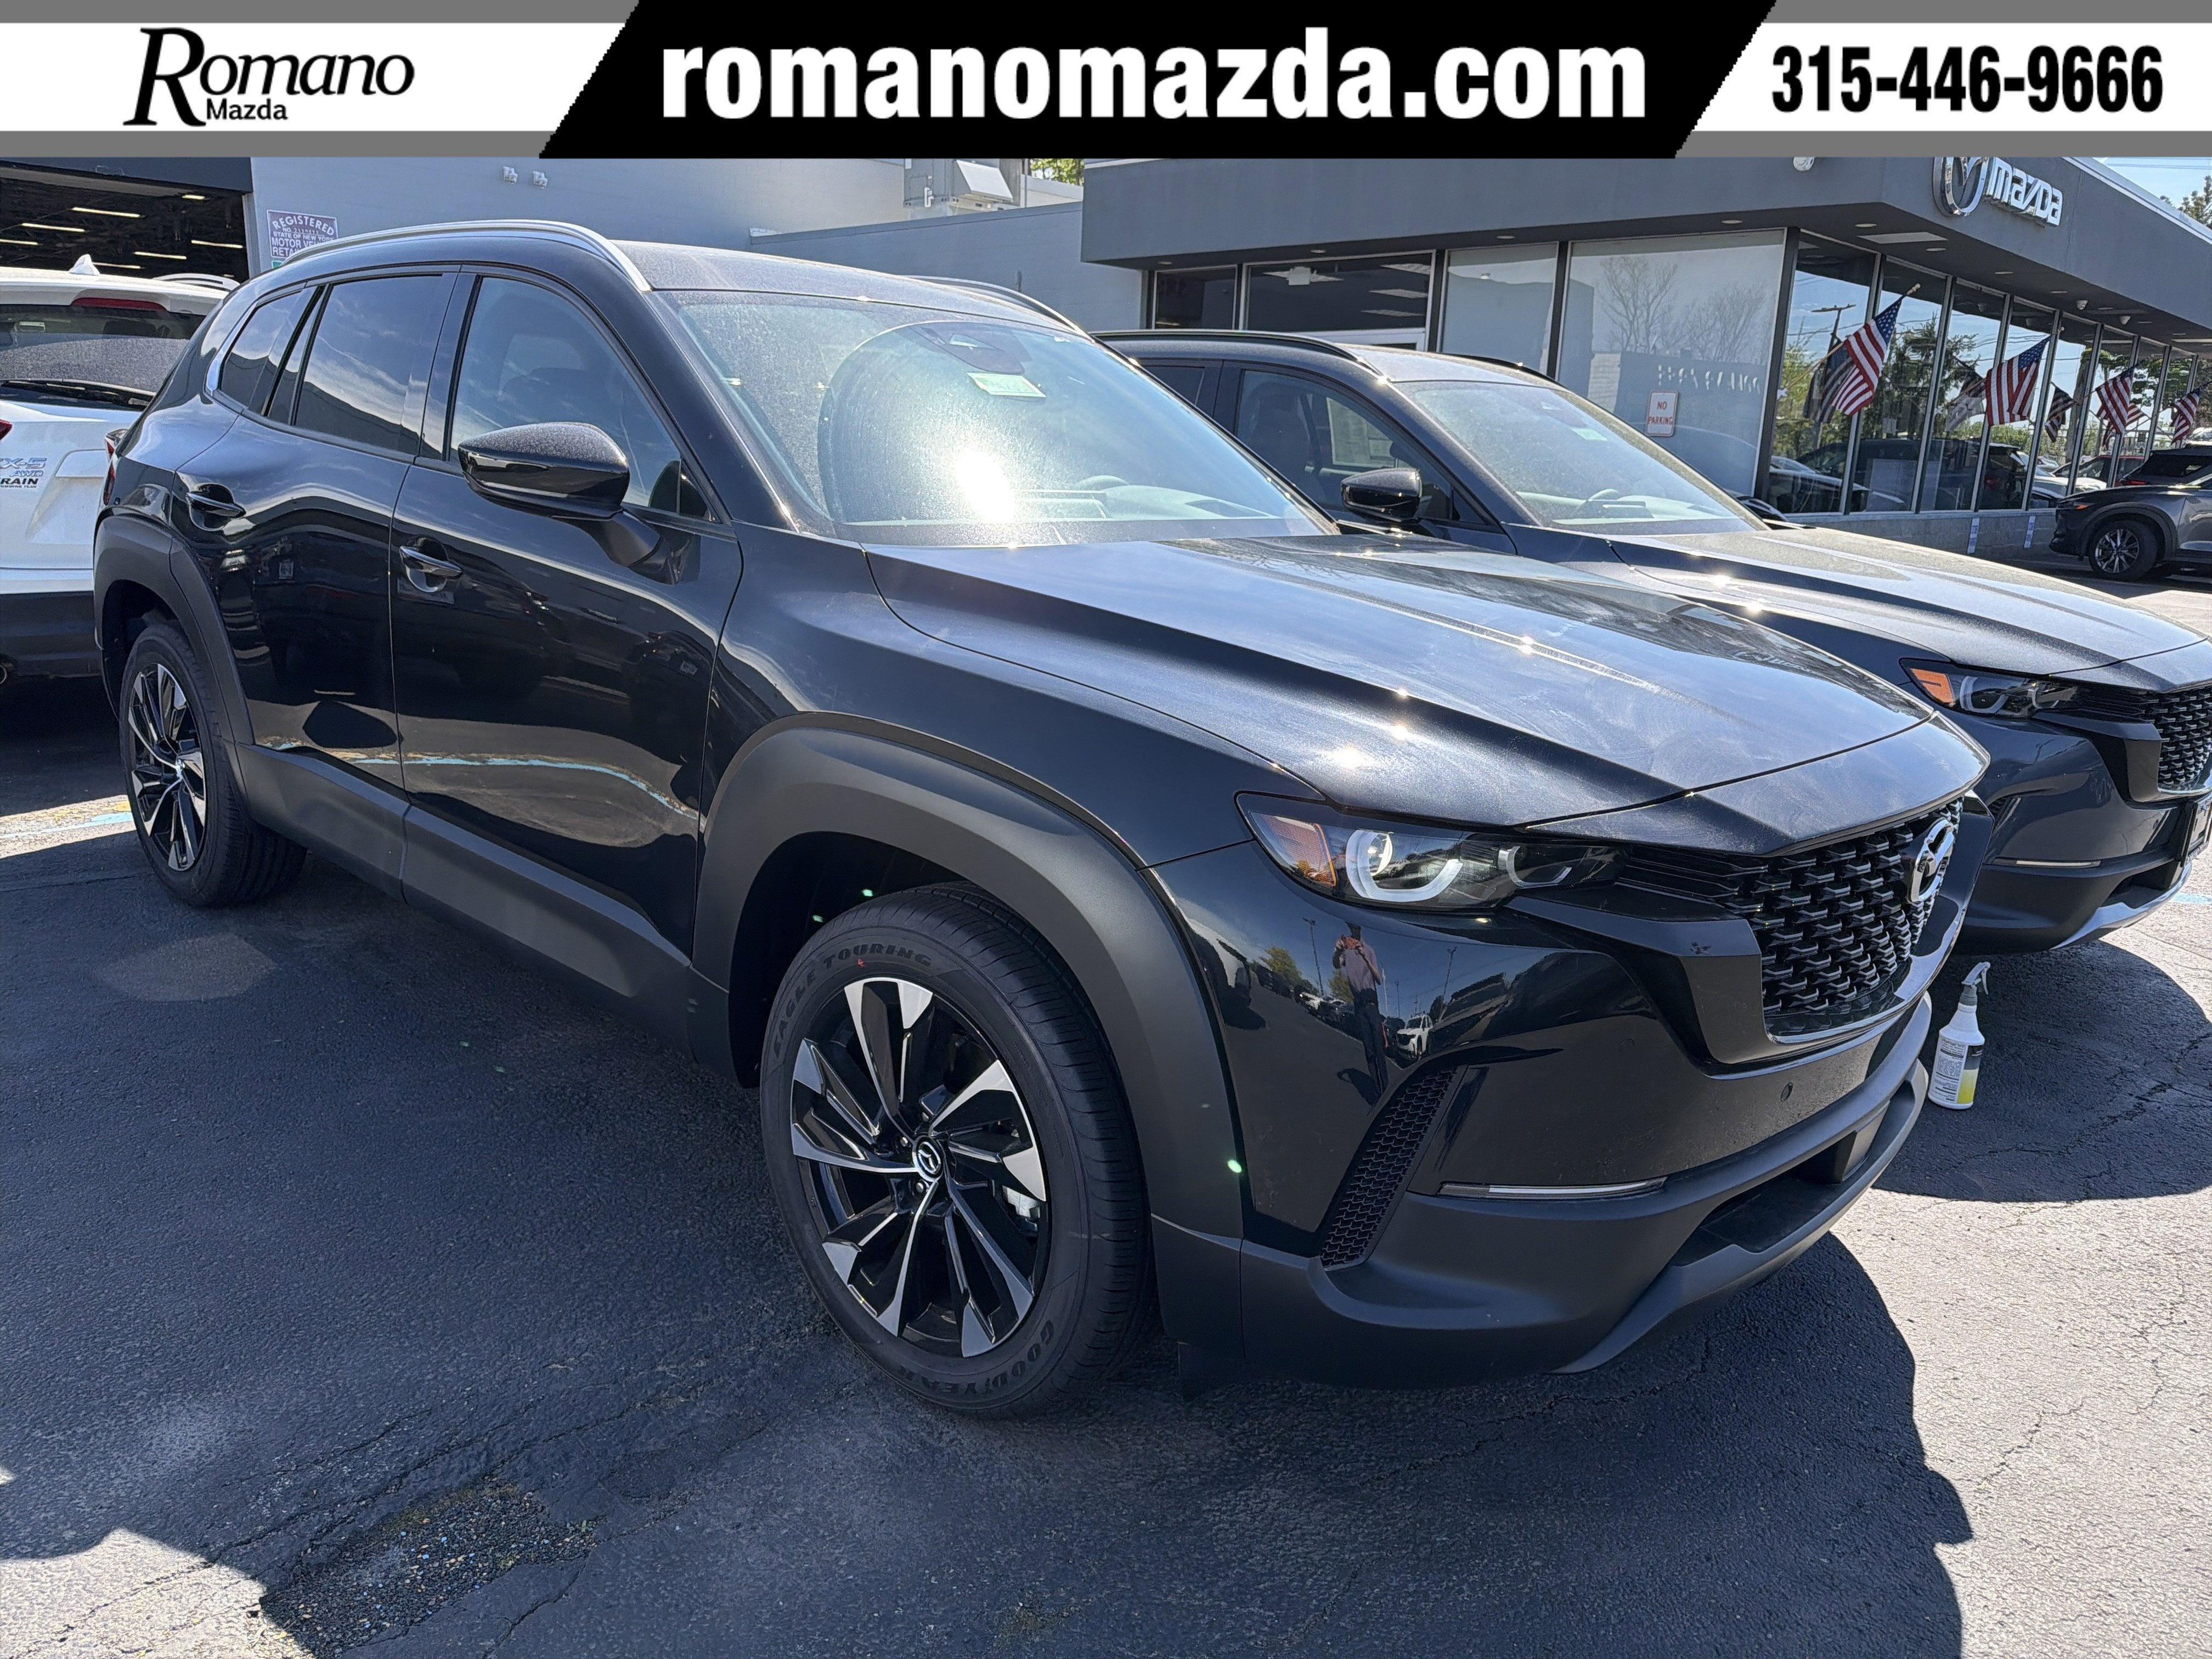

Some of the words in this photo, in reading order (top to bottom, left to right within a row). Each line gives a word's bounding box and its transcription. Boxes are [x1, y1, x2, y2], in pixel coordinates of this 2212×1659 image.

[272, 215, 334, 235] REGISTERED
[272, 237, 302, 249] MOTOR
[1657, 401, 1668, 410] NO
[1647, 416, 1674, 425] PARKING
[0, 458, 47, 469] X-5
[823, 943, 932, 969] TOURING
